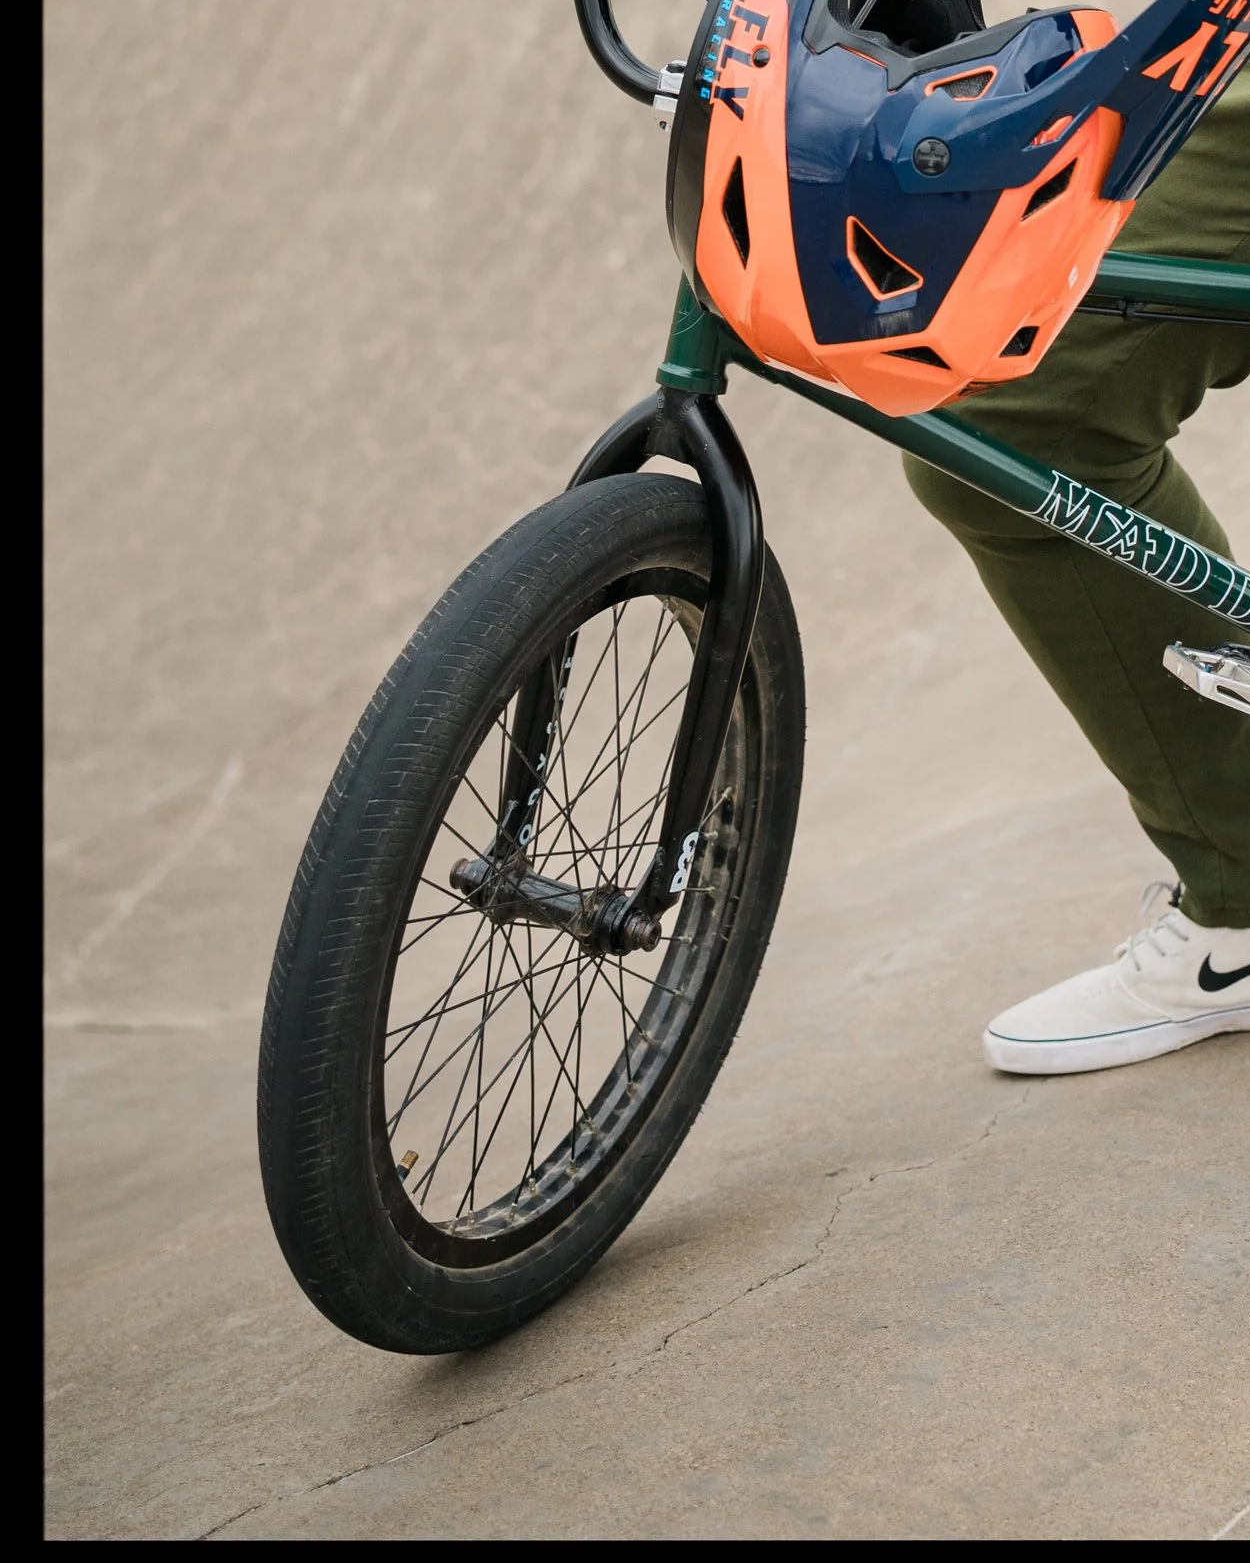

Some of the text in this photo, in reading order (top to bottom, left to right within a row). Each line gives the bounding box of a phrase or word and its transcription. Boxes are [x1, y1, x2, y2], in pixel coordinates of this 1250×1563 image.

[714, 4, 772, 122] FLY
[1141, 20, 1250, 98] LY
[1031, 469, 1211, 594] MAD
